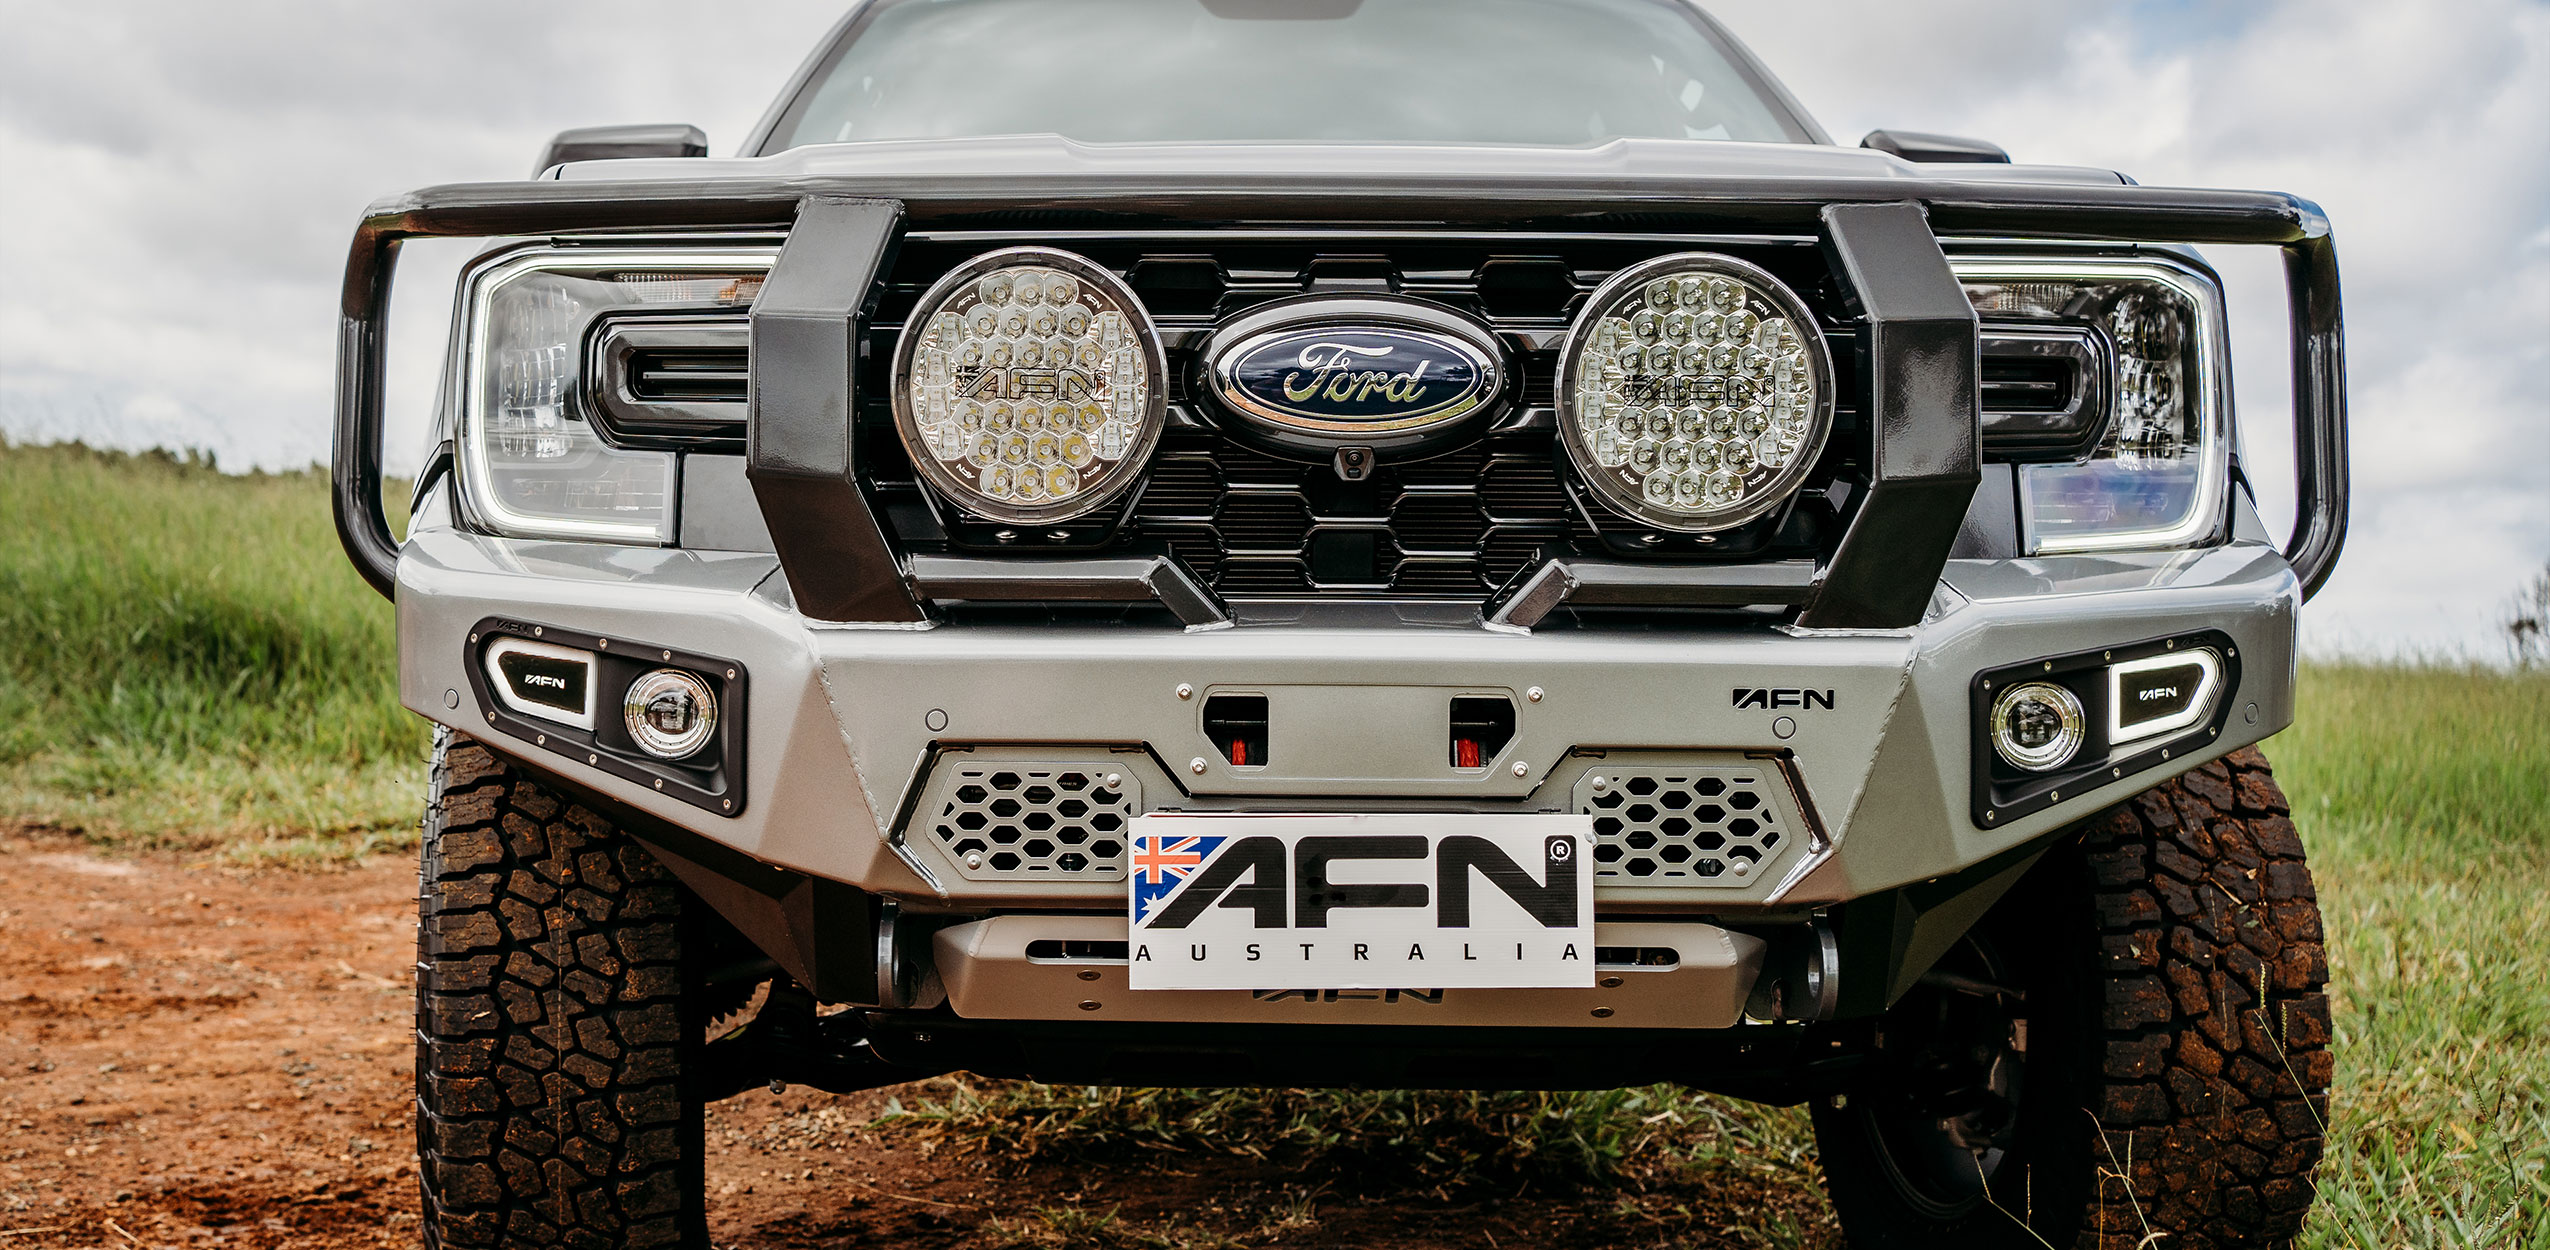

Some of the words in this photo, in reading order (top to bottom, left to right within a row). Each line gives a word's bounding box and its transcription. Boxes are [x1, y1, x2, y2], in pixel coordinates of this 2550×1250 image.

[1622, 298, 1642, 315] AFN
[1750, 299, 1771, 316] AFN
[1284, 342, 1431, 402] Ford
[957, 366, 1106, 402] AFN
[524, 674, 565, 690] AFN
[1733, 688, 1835, 710] AFN
[2139, 686, 2178, 701] AFN
[1143, 835, 1579, 929] AFN
[1135, 942, 1579, 962] AUSTRALIA
